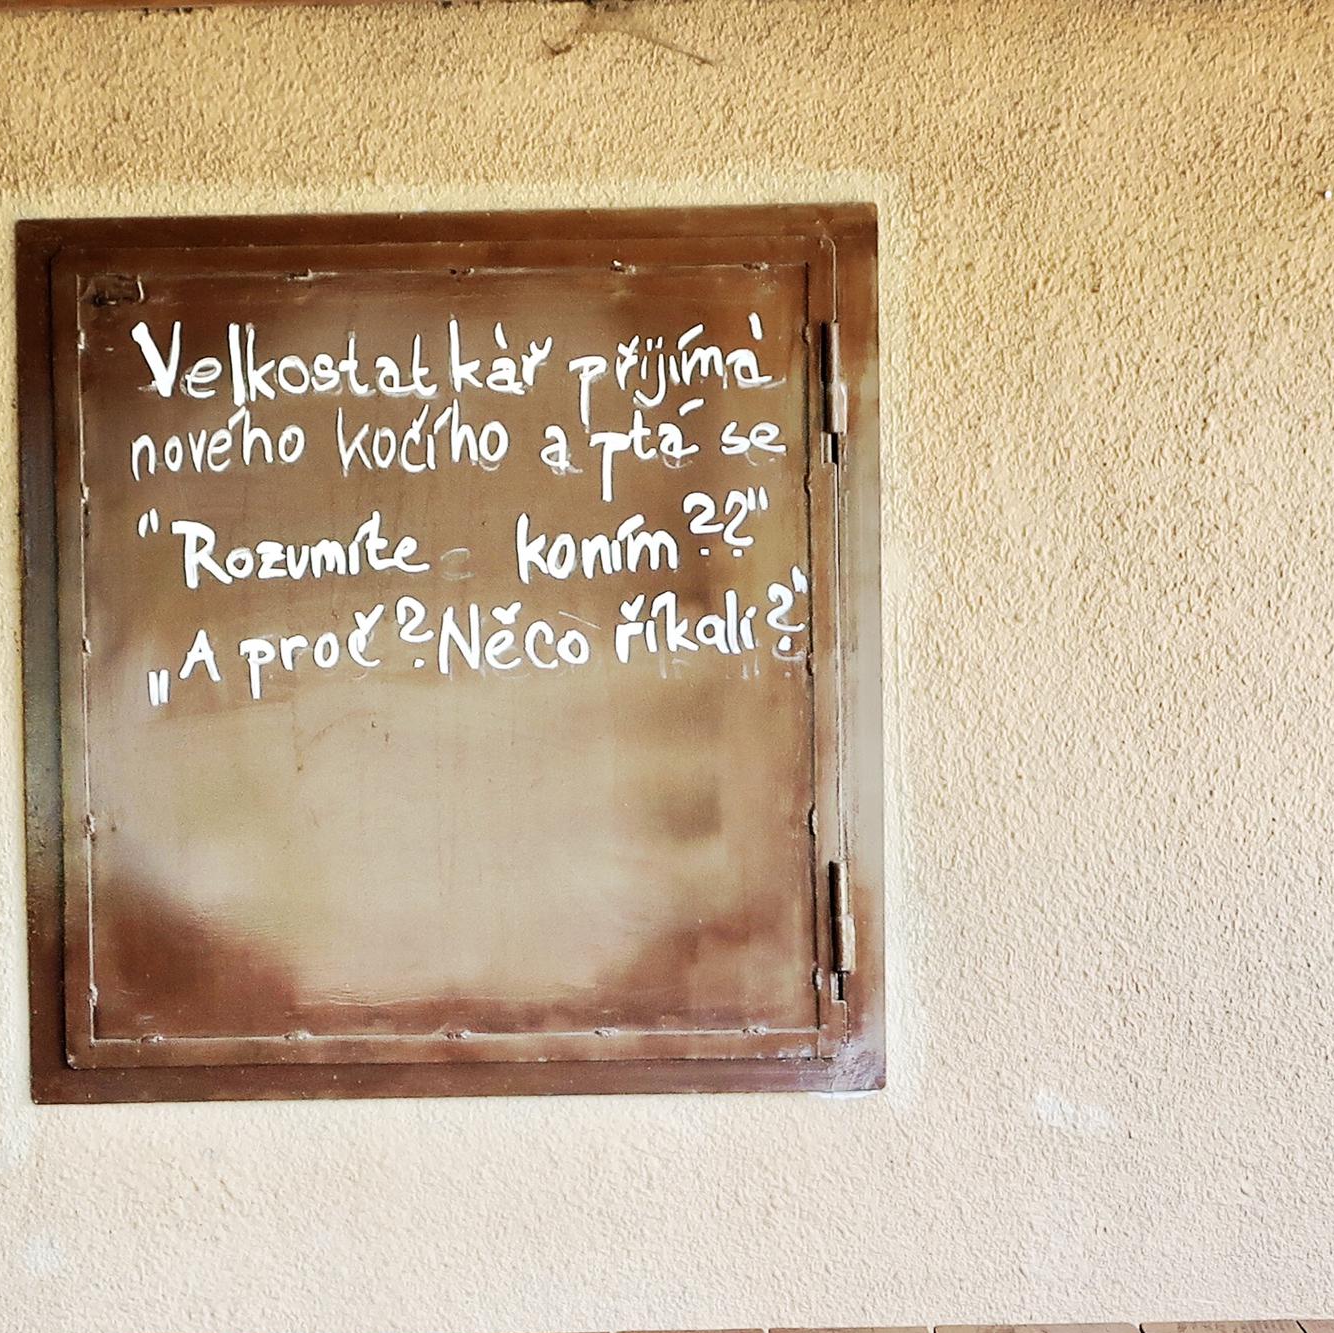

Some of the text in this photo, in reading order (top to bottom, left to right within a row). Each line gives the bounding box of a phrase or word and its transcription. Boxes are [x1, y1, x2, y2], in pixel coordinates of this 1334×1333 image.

[130, 398, 788, 502] nového kočího a ptá se
